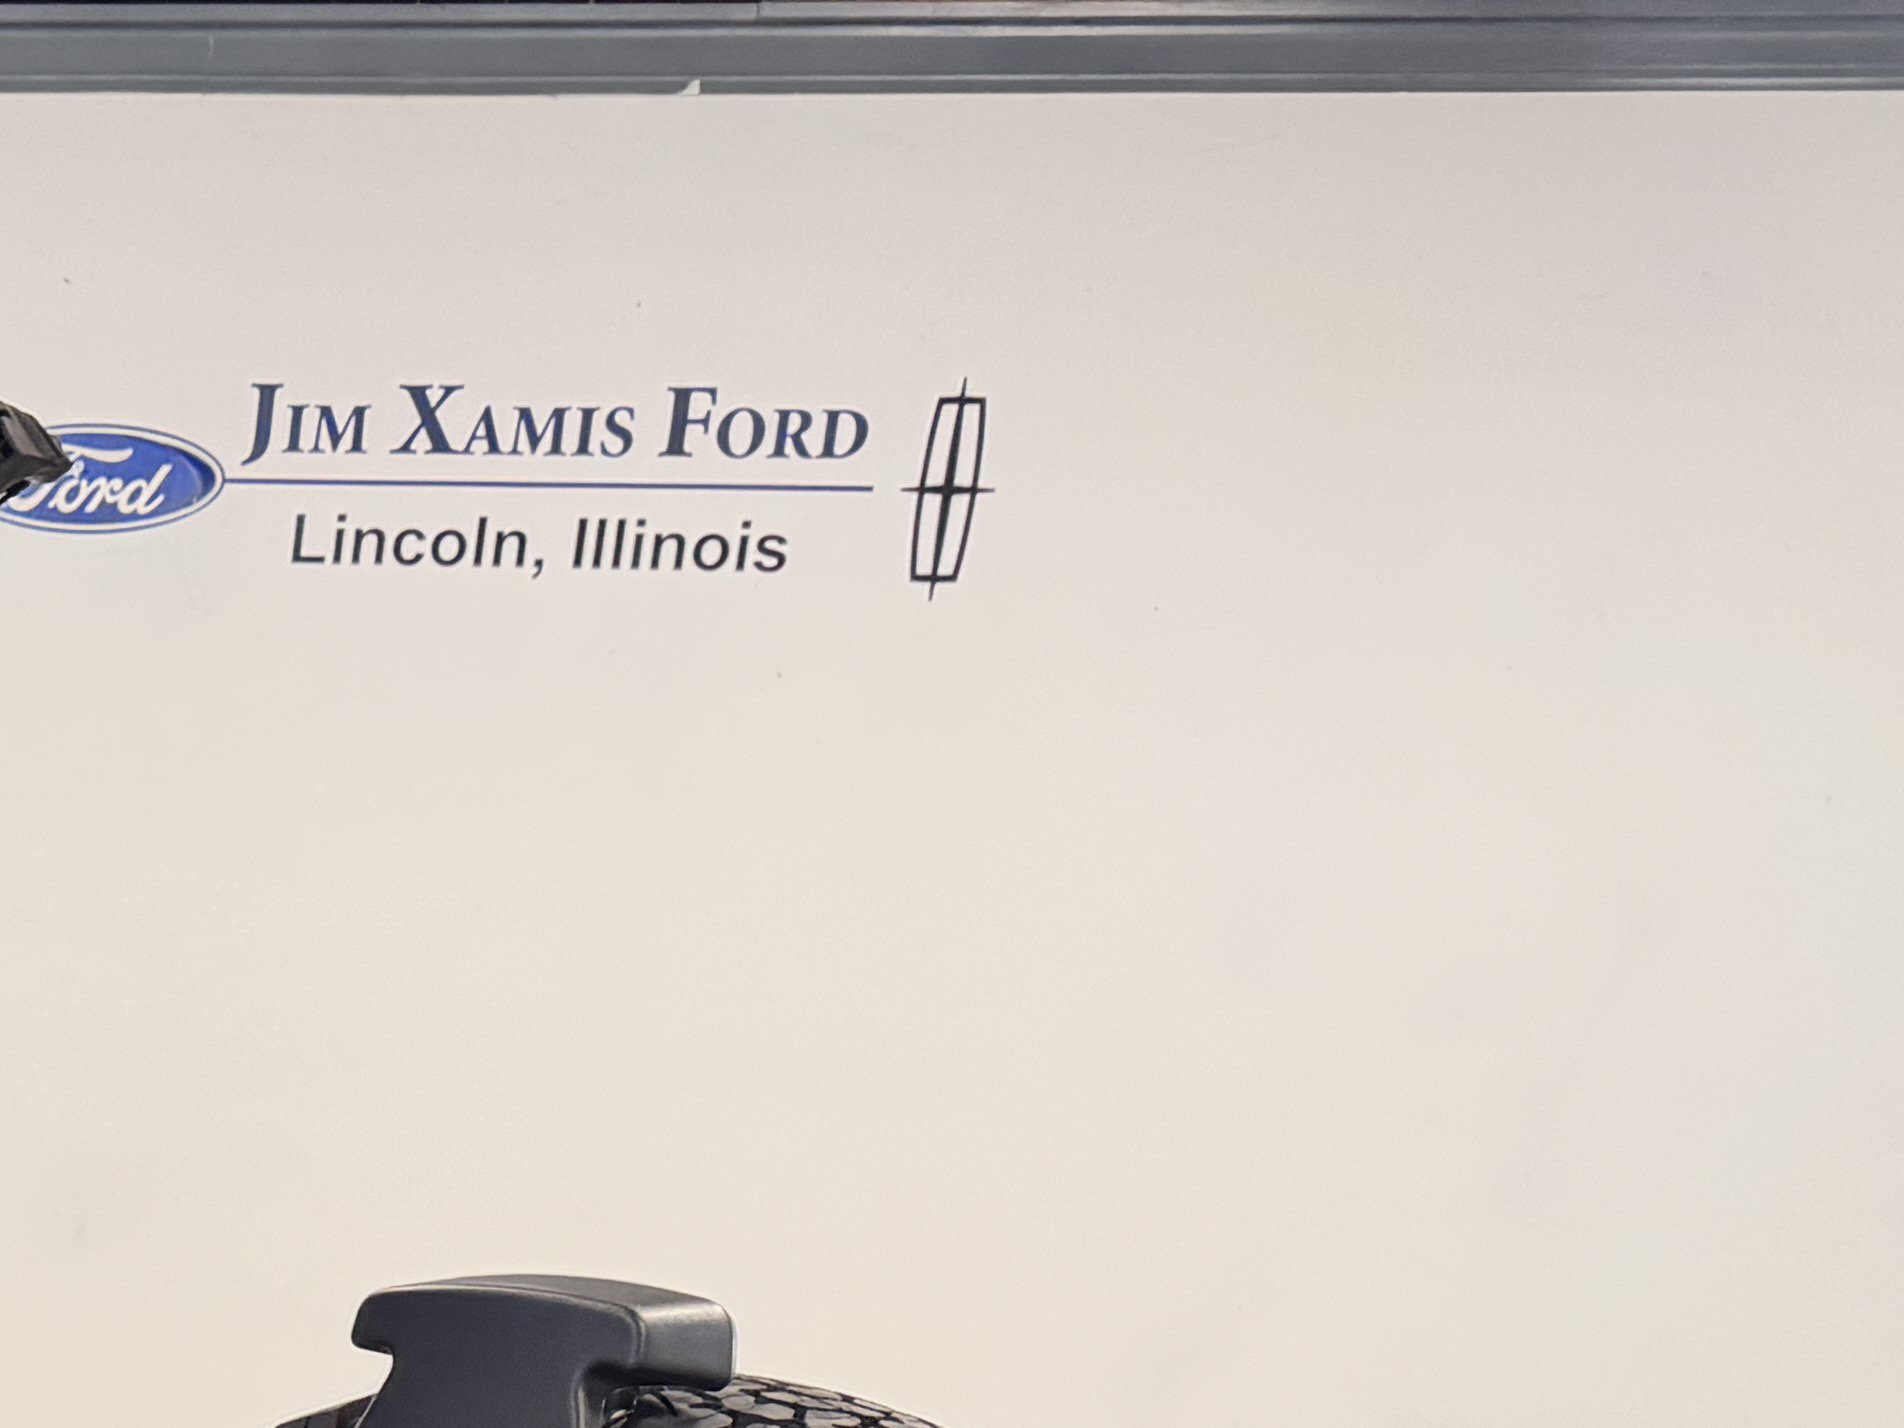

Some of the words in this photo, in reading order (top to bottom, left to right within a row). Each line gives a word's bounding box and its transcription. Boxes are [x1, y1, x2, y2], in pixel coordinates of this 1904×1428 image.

[242, 382, 370, 466] JIM
[390, 384, 635, 458] XAMIS
[659, 386, 869, 459] FORD
[291, 514, 544, 578] Lincoln,
[572, 518, 787, 573] Illinois
